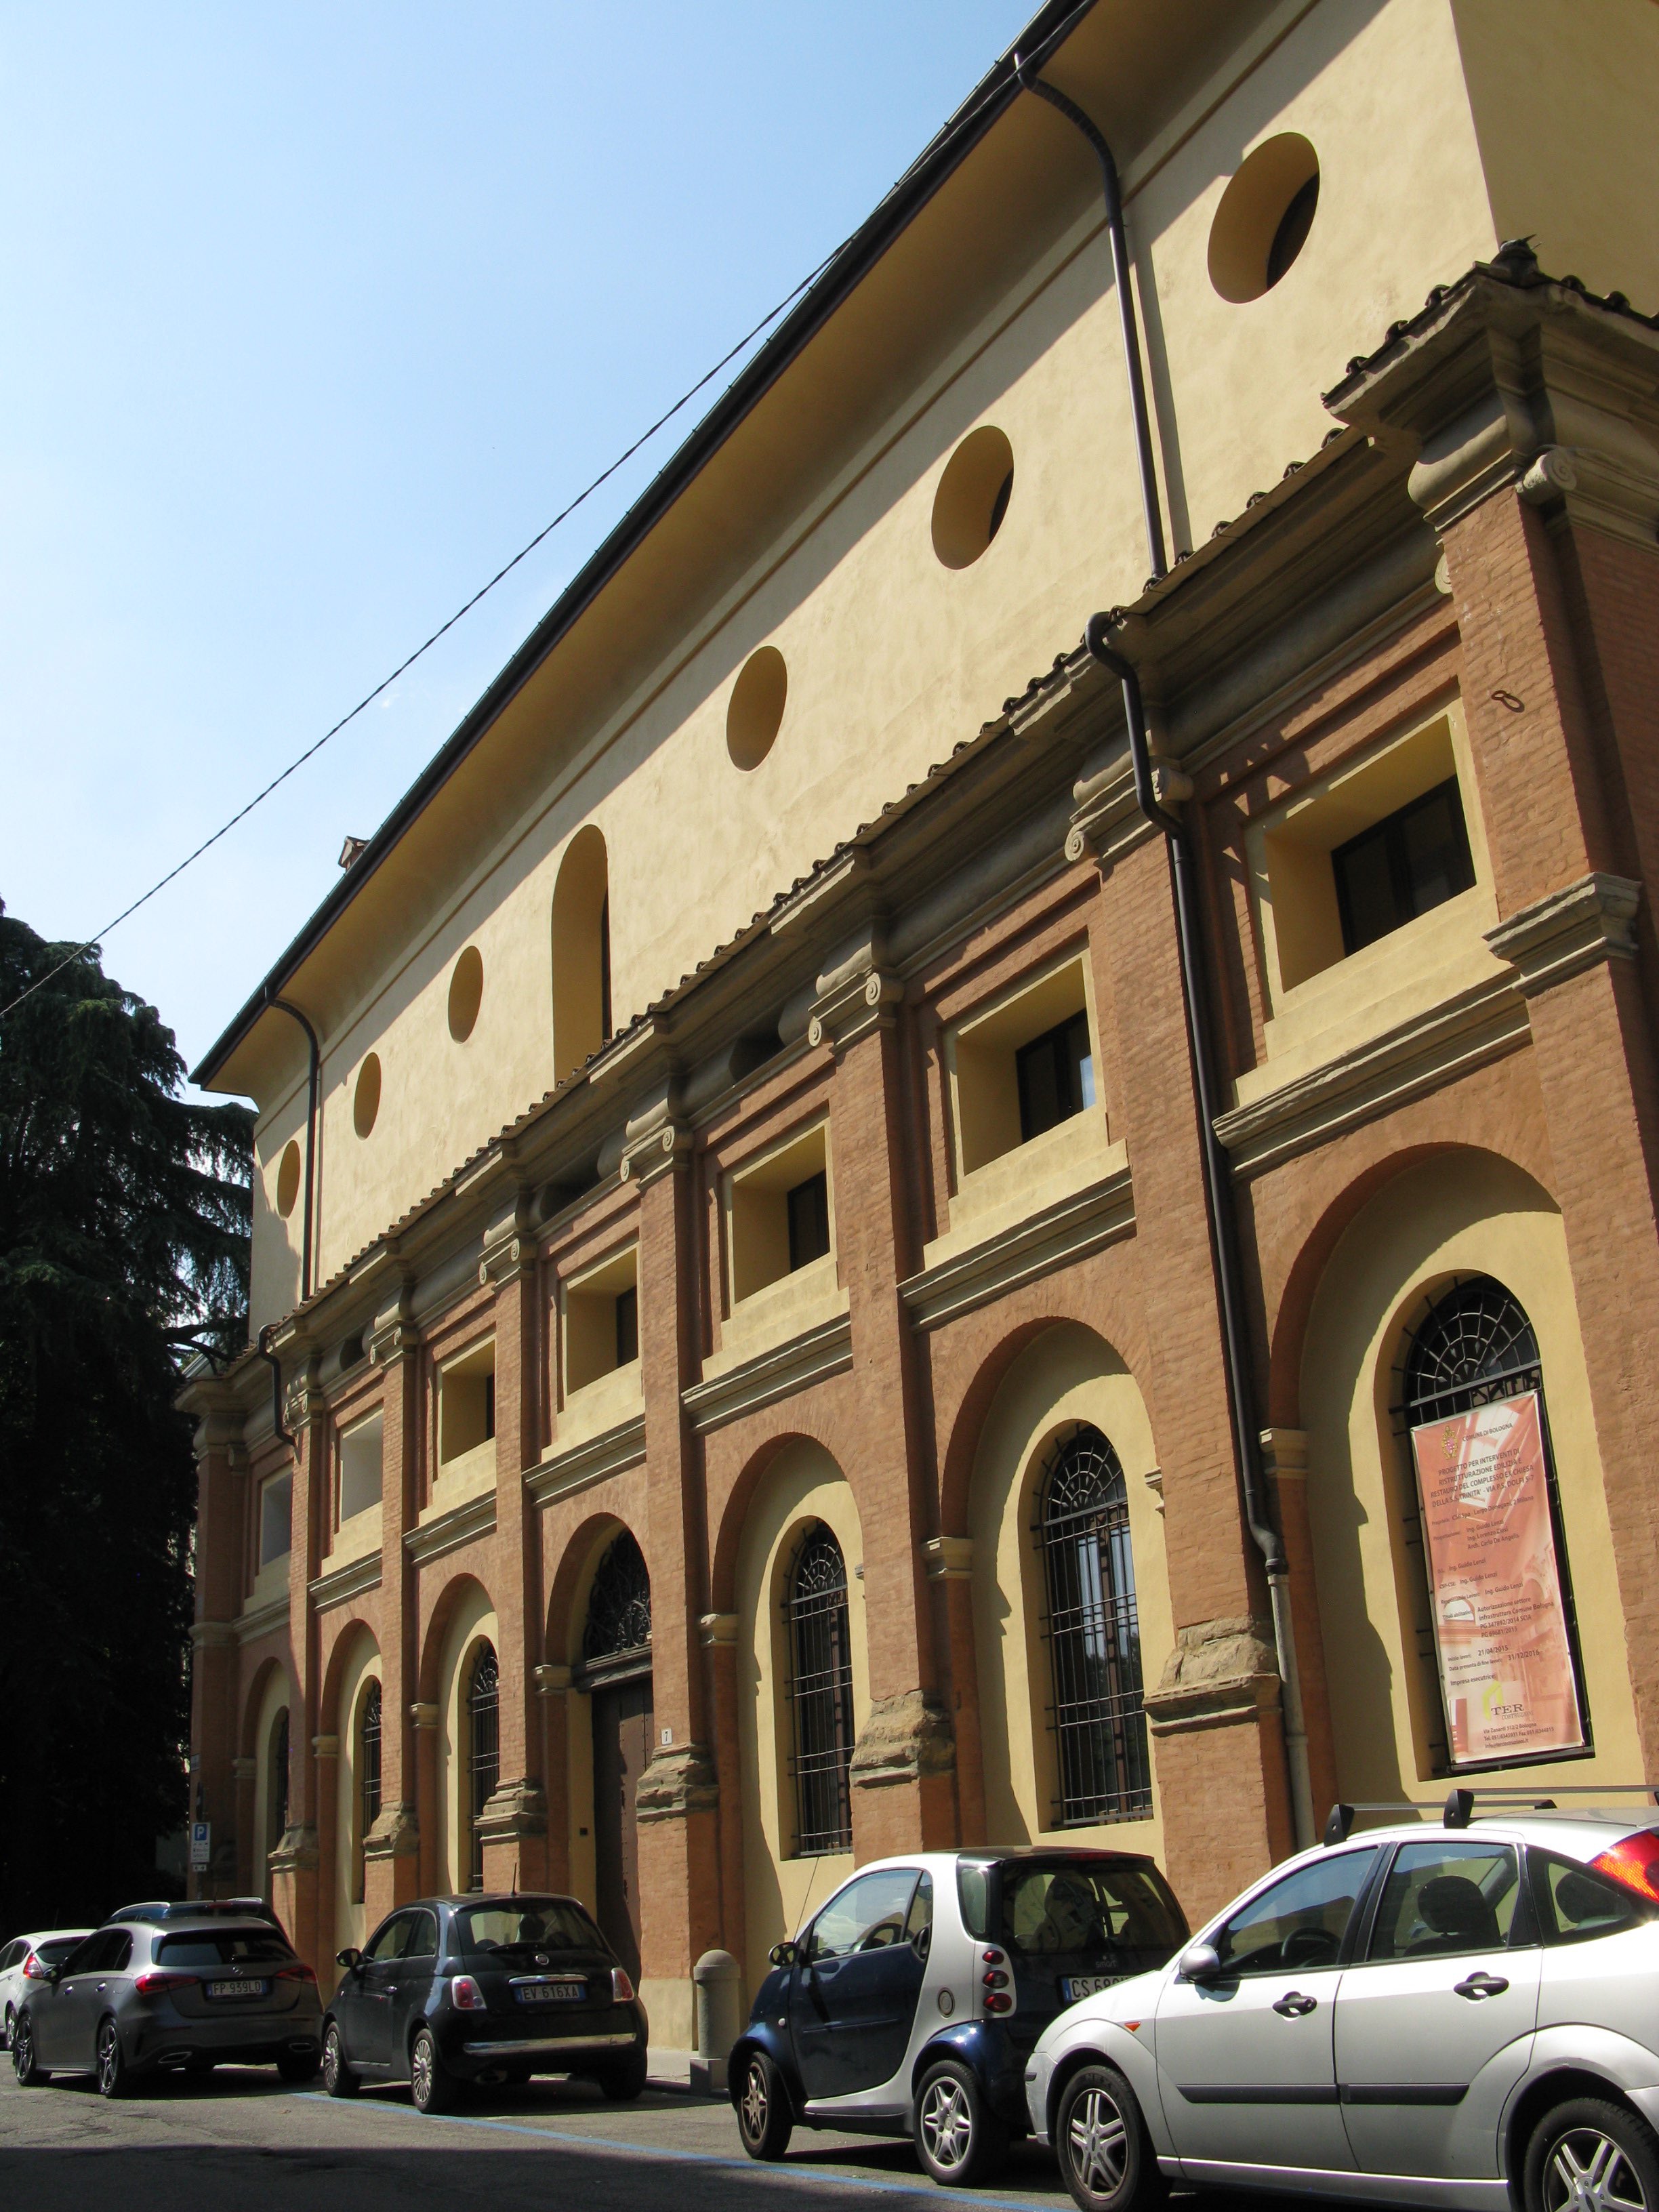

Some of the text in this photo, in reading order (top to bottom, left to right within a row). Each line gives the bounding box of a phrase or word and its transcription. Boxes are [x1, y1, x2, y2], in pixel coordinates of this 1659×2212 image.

[1462, 1431, 1483, 1442] COMUNE
[1490, 1422, 1513, 1434] BOLOGNA
[1439, 1462, 1467, 1476] PROGETTO
[1469, 1459, 1479, 1467] PER
[1479, 1450, 1512, 1465] INTERVENTI
[1439, 1465, 1492, 1486] RISTRUTTURAZIONE
[1494, 1458, 1517, 1471] EDILIZIA
[1431, 1485, 1458, 1498] RESTAURO
[1459, 1482, 1469, 1490] DEL
[1470, 1472, 1503, 1487] COMPLESSO
[1513, 1464, 1533, 1475] CHIESA
[1432, 1498, 1448, 1508] DELLA
[1486, 1485, 1496, 1493] VIA
[1507, 1477, 1524, 1487] DOLFI
[1478, 1645, 1509, 1656] 21/04/2015
[1508, 1649, 1540, 1660] 31/12/2016
[1450, 1677, 1469, 1687] Impresa
[1491, 1702, 1524, 1716] TER
[213, 1984, 226, 1994] FP
[523, 1987, 537, 2000] EV
[1071, 1979, 1091, 1998] CS
